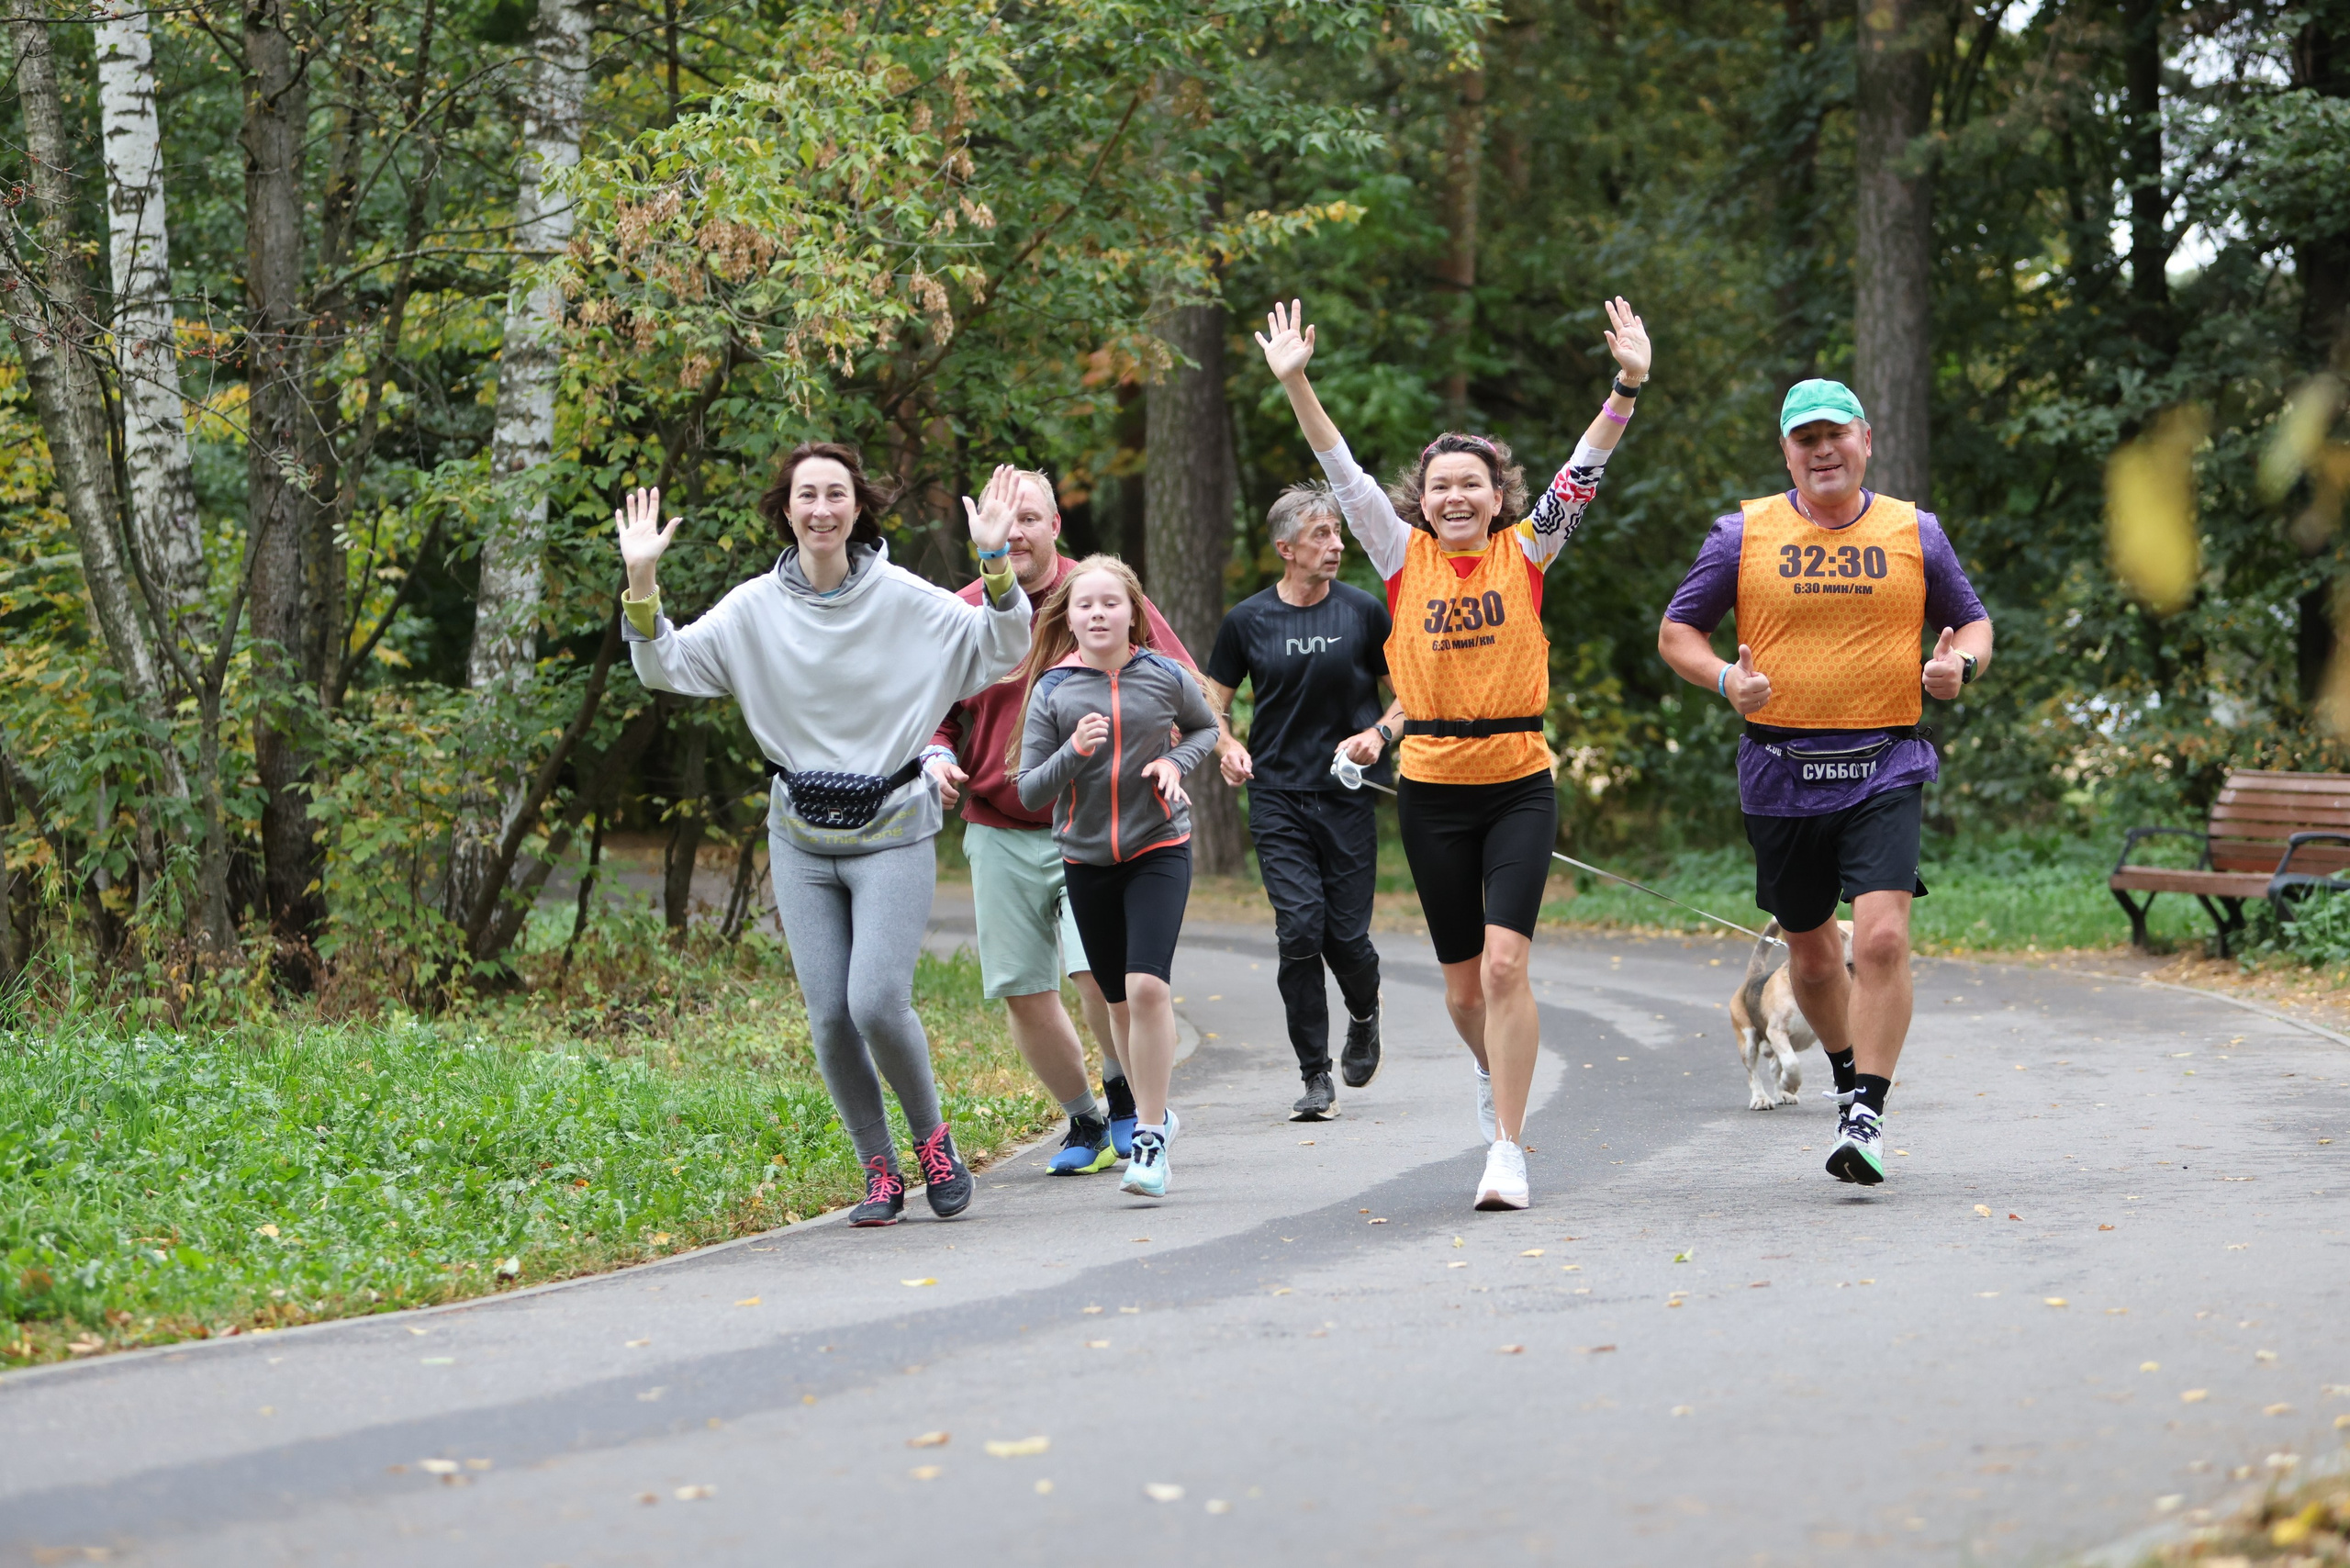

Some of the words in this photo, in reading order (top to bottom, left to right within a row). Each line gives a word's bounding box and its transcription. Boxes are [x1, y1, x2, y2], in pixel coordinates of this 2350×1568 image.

[1779, 543, 1887, 578] 32:30
[1794, 582, 1819, 594] 6:30
[1424, 590, 1505, 633] 32:30
[1286, 635, 1326, 655] run
[1432, 639, 1451, 651] 6:30
[1802, 760, 1877, 780] СУББОТА
[822, 834, 858, 845] This
[862, 824, 903, 842] Long
